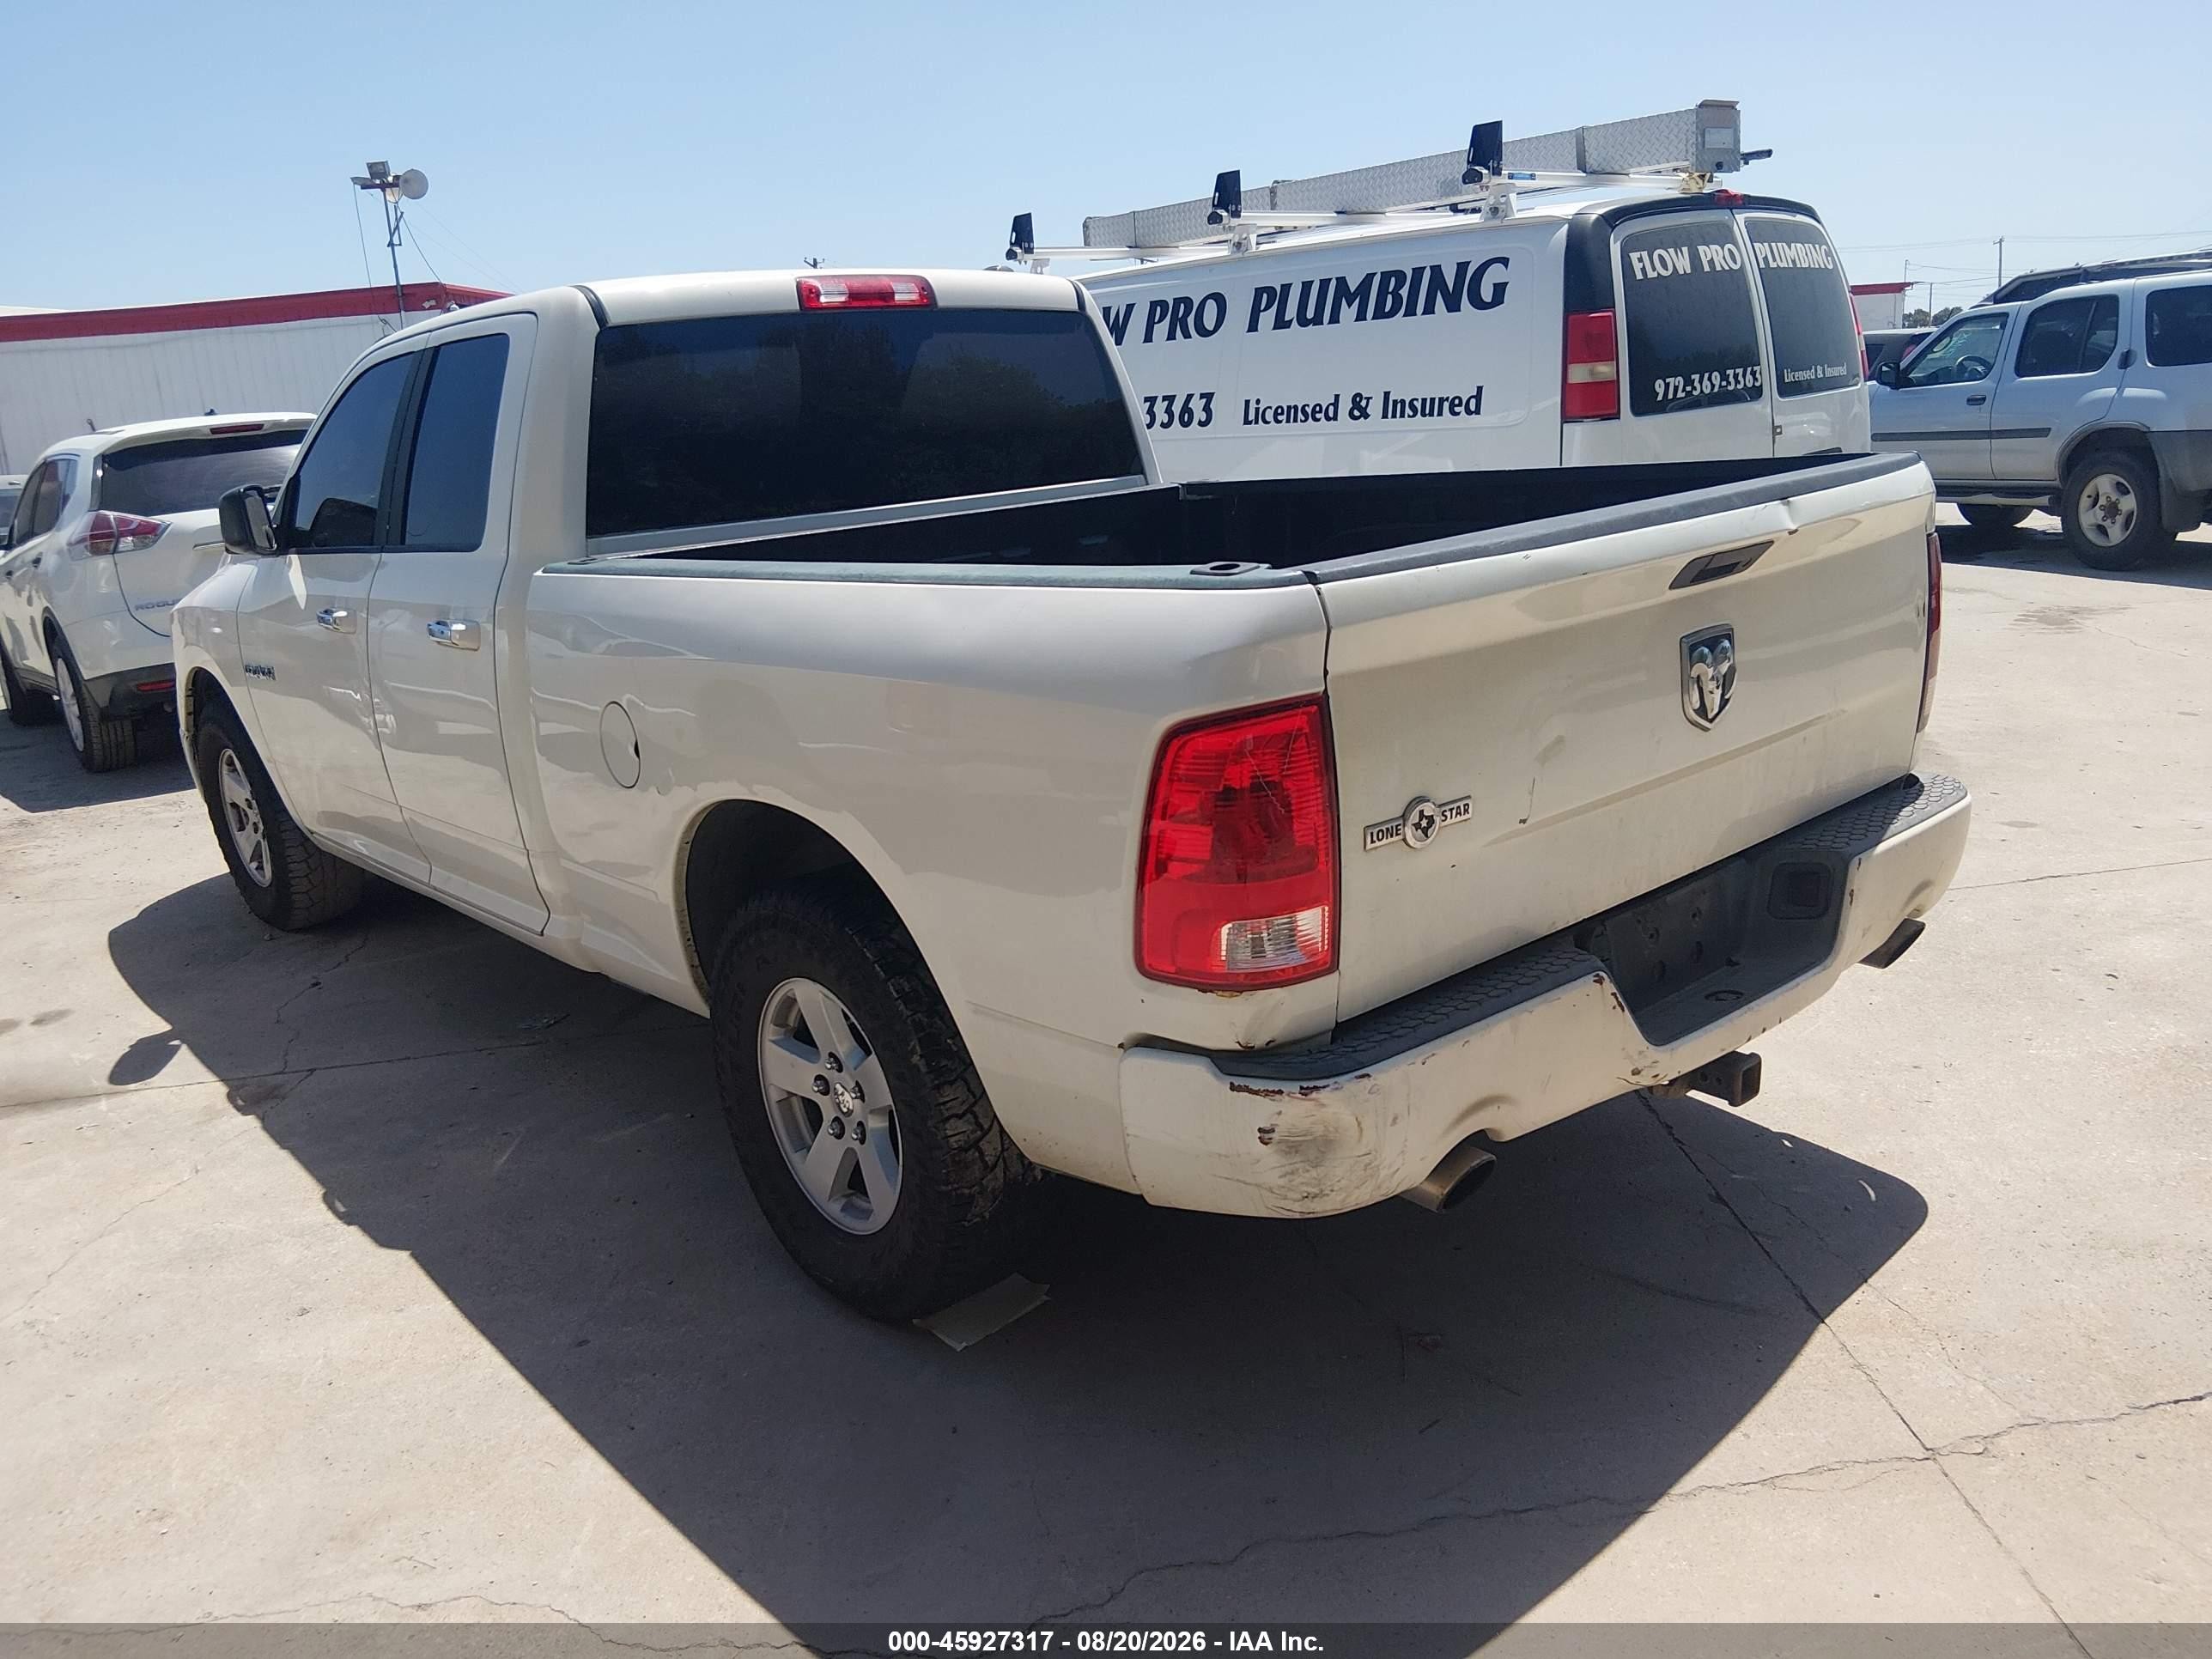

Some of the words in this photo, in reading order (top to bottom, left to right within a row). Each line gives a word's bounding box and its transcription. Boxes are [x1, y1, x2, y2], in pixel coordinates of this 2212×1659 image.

[1628, 246, 1692, 280] FLOW
[1697, 243, 1742, 272] PRO
[1753, 242, 1833, 270] PLUMBING
[1142, 291, 1228, 344] PRO
[1245, 256, 1510, 333] PLUMBING
[1654, 365, 1761, 402] 972-369-3363
[1784, 365, 1815, 383] Licensed
[1816, 365, 1823, 379] &
[1824, 362, 1847, 378] Insured
[1143, 392, 1216, 430] 3363
[1243, 393, 1340, 426] Licensed
[1347, 392, 1373, 421] &
[1380, 385, 1485, 420] Insured
[1370, 823, 1402, 845] LONE
[1441, 802, 1471, 823] STAR
